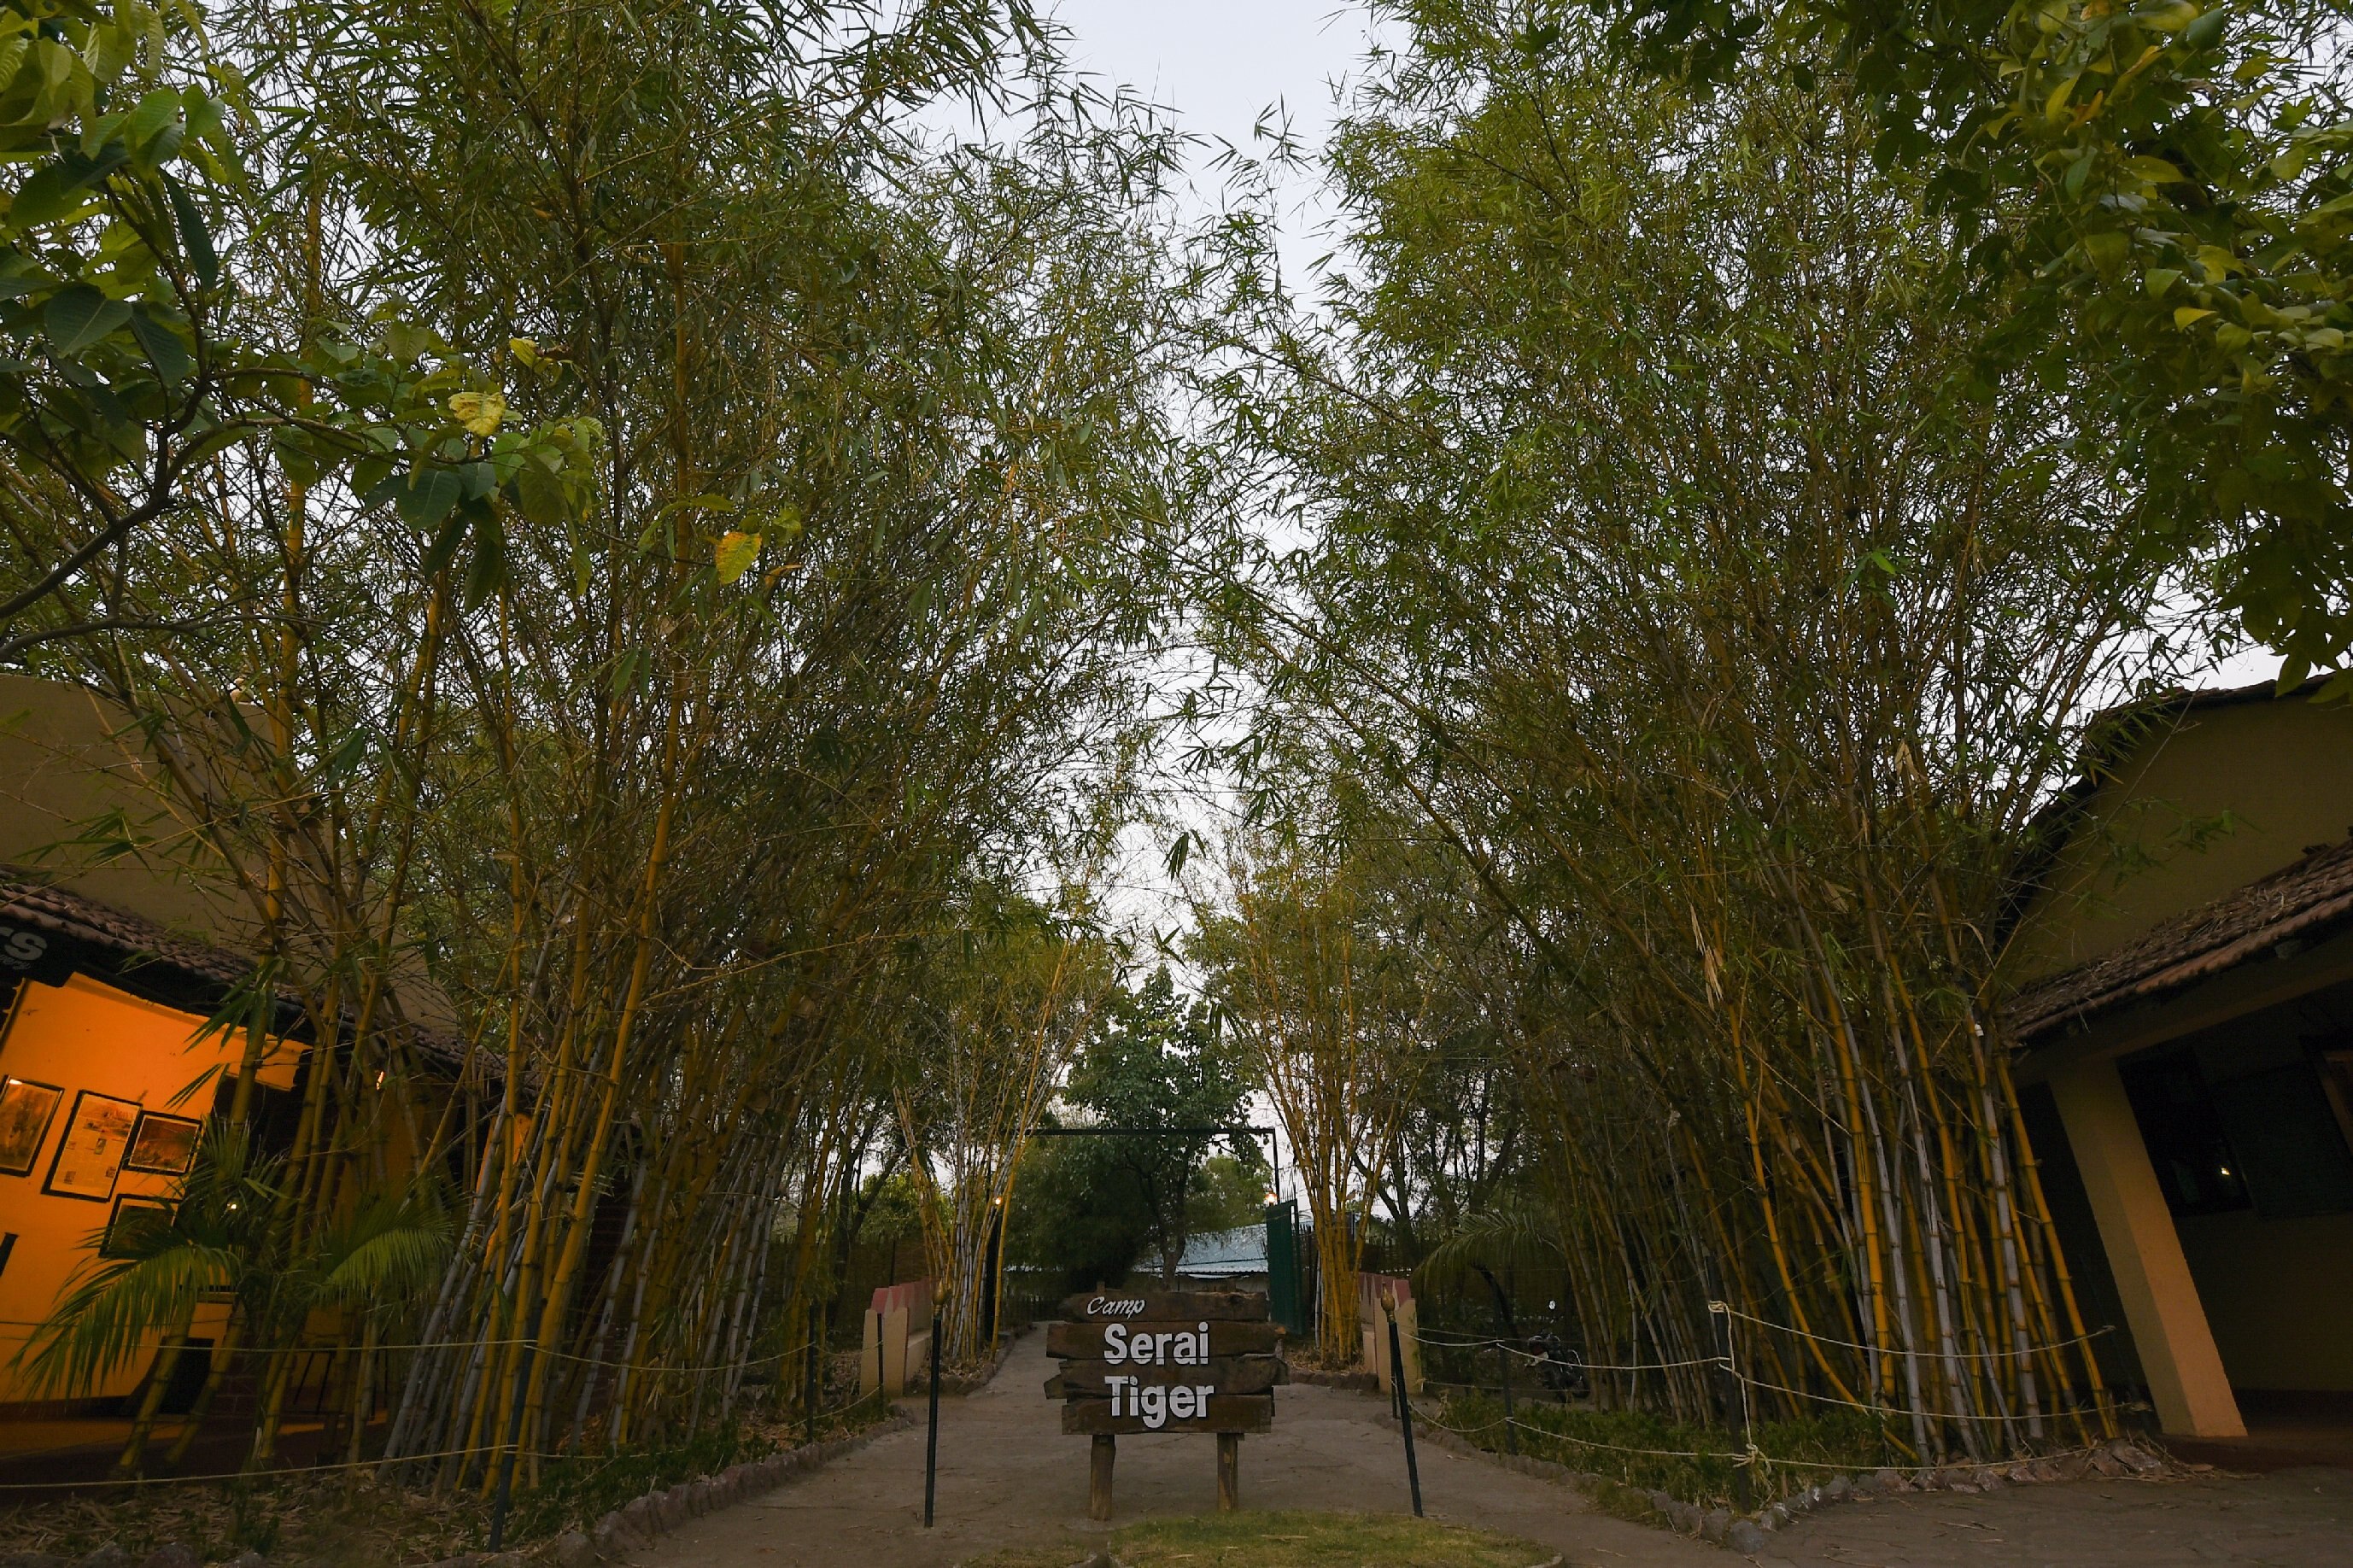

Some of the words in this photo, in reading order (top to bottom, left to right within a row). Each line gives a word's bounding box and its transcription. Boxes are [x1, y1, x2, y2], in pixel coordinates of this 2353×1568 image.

[1086, 1296, 1145, 1319] Camp
[1103, 1321, 1209, 1366] Serai
[1104, 1375, 1215, 1429] Tiger
